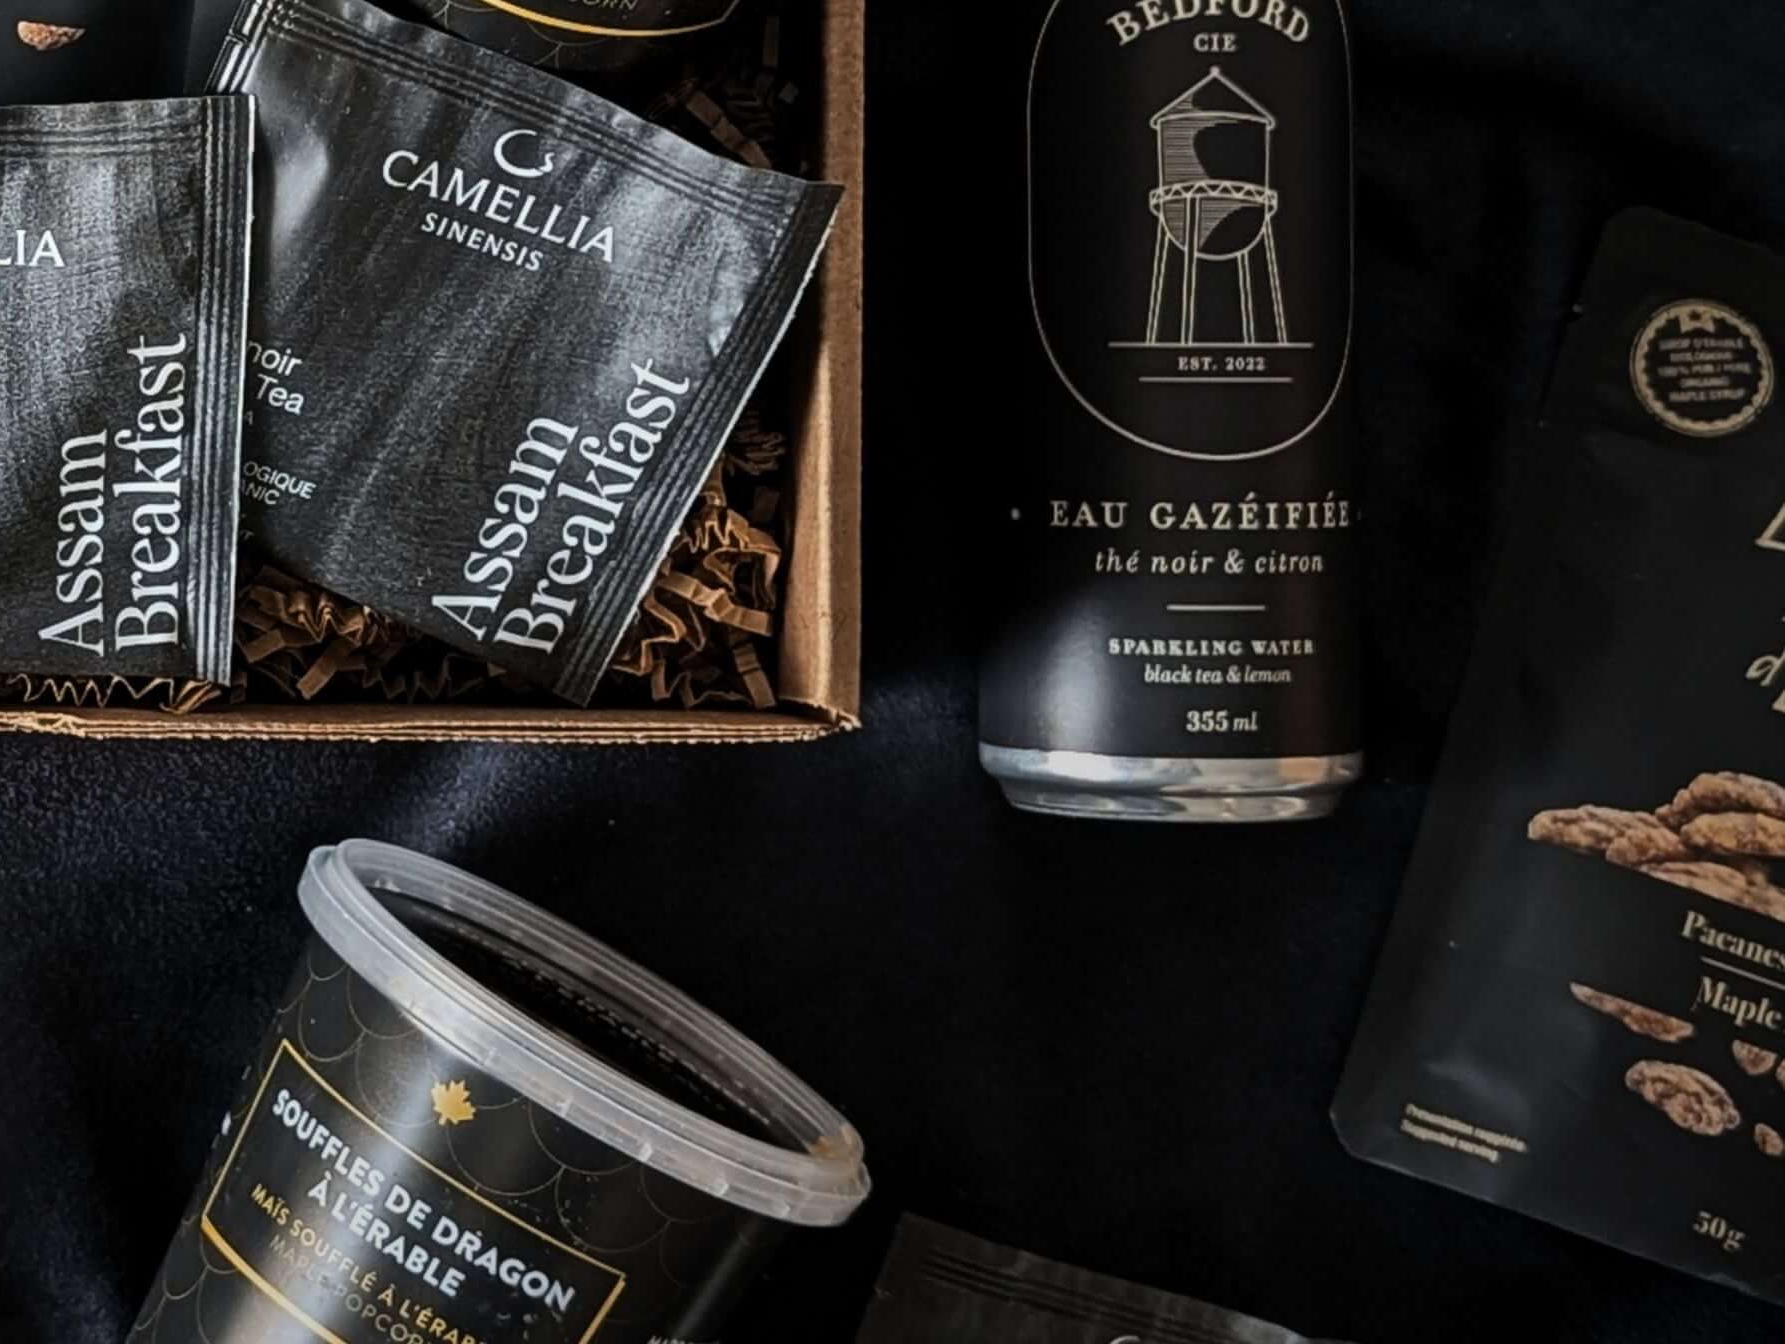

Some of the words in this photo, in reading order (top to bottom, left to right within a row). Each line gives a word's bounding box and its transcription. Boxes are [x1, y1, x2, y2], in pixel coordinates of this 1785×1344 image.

[1193, 32, 1239, 53] CIE
[381, 149, 619, 264] CAMELLIA
[420, 210, 545, 273] SINENSIS
[247, 339, 303, 376] noir
[1177, 356, 1219, 373] EST.
[1225, 356, 1267, 373] 2022
[257, 373, 304, 415] Tea
[114, 333, 189, 648] Breakfast
[494, 358, 692, 655] Breakfast
[1049, 499, 1129, 529] EAU
[1149, 490, 1352, 531] GAZÉIFIÉE
[38, 429, 108, 657] Assam
[431, 413, 581, 644] Assam
[1095, 548, 1139, 574] thé
[1150, 550, 1214, 575] noir
[1223, 552, 1245, 575] &
[1254, 551, 1324, 575] citron
[1108, 638, 1243, 656] SPARKLING
[1250, 639, 1315, 656] WATER
[1143, 663, 1192, 684] black
[1195, 668, 1223, 684] tea
[1226, 666, 1242, 684] &
[1244, 665, 1292, 684] lemon
[1186, 710, 1229, 733] 355
[1232, 711, 1259, 732] ml
[1695, 976, 1783, 1030] Maple
[272, 1087, 386, 1198] SOUFFLES
[384, 1184, 431, 1232] DE
[432, 1215, 576, 1314] DRAGON
[250, 1183, 291, 1226] MAÏS
[290, 1217, 381, 1293] SOUFFLÉ
[377, 1279, 398, 1310] À
[308, 1170, 329, 1209] À
[332, 1192, 469, 1299] L'ÉRABLE
[1692, 1209, 1746, 1251] 50g
